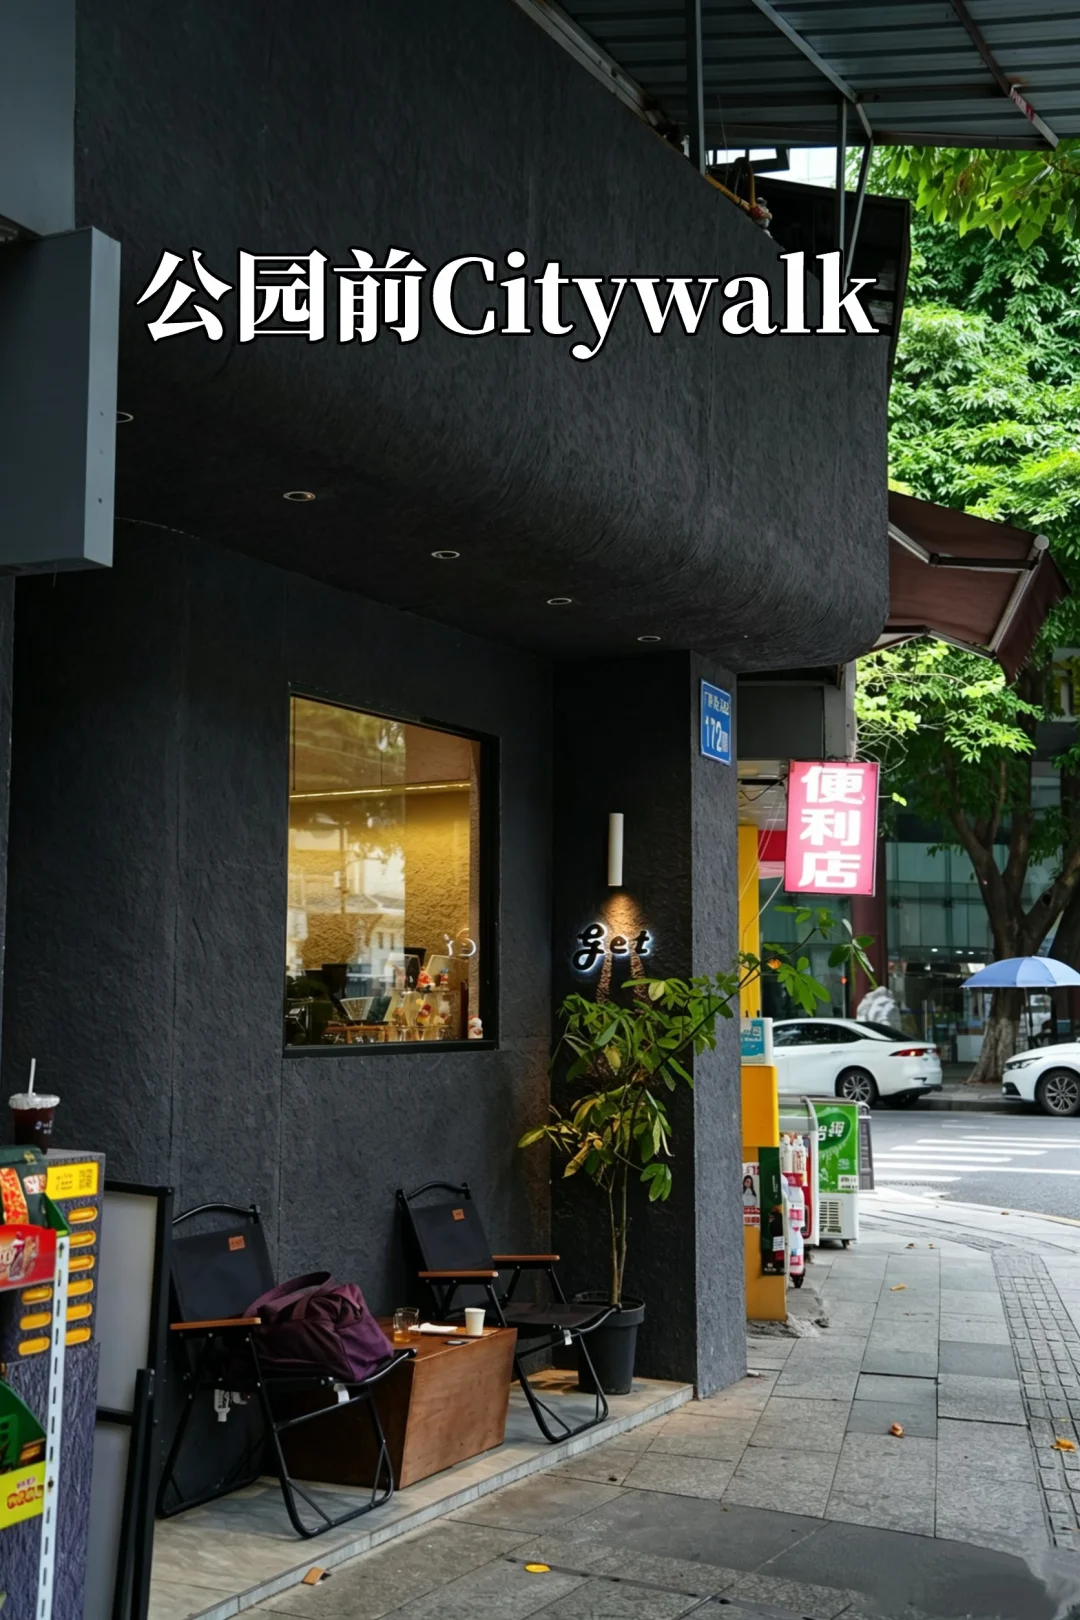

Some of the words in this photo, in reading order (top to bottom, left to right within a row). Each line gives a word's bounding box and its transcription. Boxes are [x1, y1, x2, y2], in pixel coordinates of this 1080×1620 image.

[798, 765, 866, 890] 便利店
[571, 922, 651, 971] get
